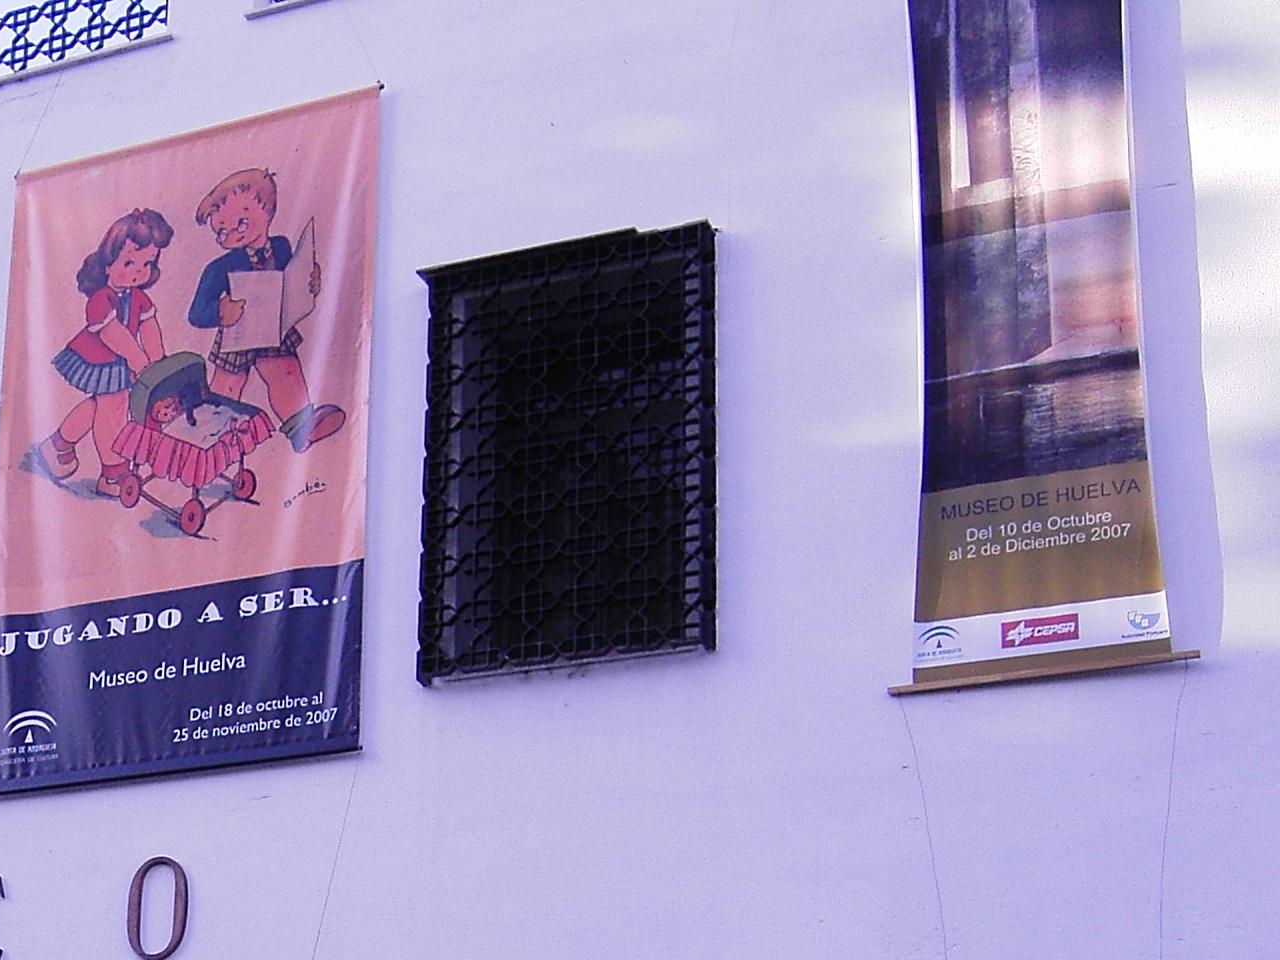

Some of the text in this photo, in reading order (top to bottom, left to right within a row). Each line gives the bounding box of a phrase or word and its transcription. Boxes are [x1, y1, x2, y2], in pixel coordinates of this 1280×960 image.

[940, 477, 1142, 521] MUSEO DE HUELVA
[948, 522, 1131, 562] al 2 de Diciembre 2007
[966, 509, 1113, 543] Del 10 de Octubre
[196, 600, 224, 624] A
[238, 586, 348, 619] SER...
[89, 651, 246, 690] Museo de Huelva
[172, 707, 338, 744] 25 de noviembre de 2007
[189, 691, 324, 722] Del 18 de octubre al
